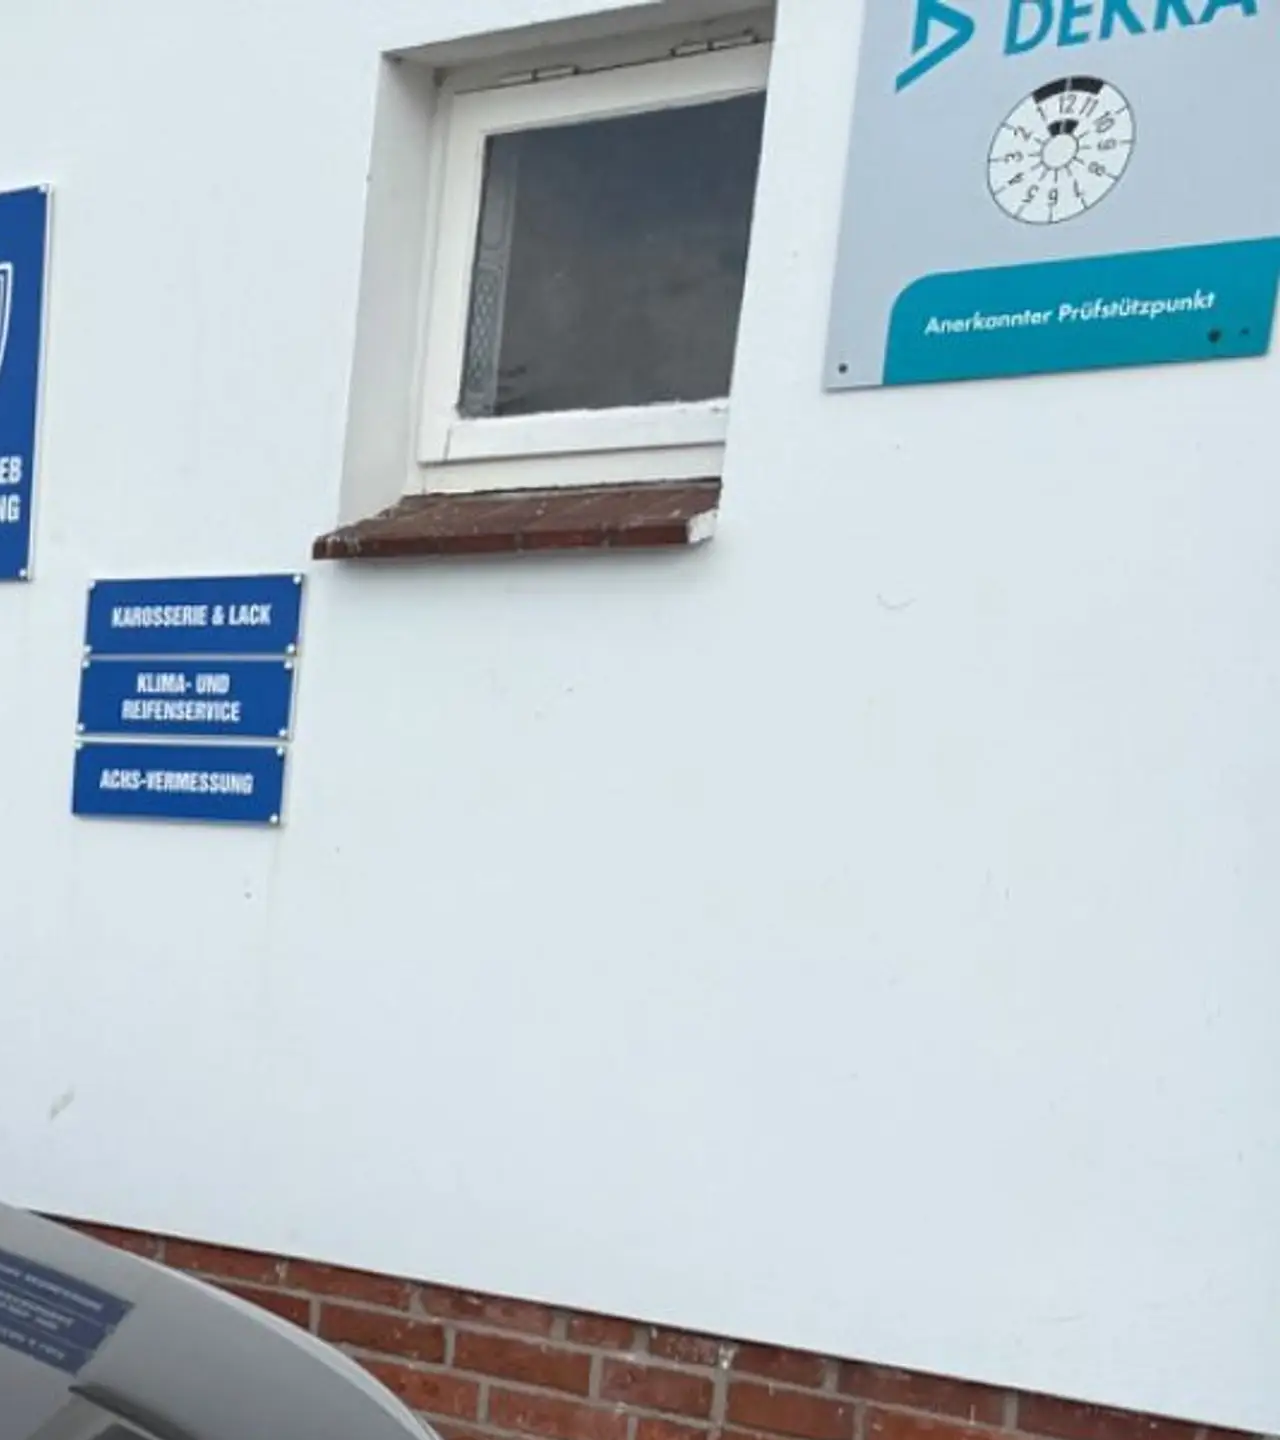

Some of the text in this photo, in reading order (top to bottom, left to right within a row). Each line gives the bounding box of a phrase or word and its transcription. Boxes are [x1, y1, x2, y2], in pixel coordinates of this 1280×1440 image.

[1003, 0, 1258, 55] DEK
[1059, 94, 1077, 114] 12
[924, 288, 1216, 336] Anerkannter Prüfstützpunkt
[111, 603, 273, 628] KAROSSERIE & LACK
[136, 672, 231, 695] KLIMA- UND
[121, 698, 243, 723] REIFENSERVICE
[99, 768, 255, 796] ACHS-VERMESSUNG
